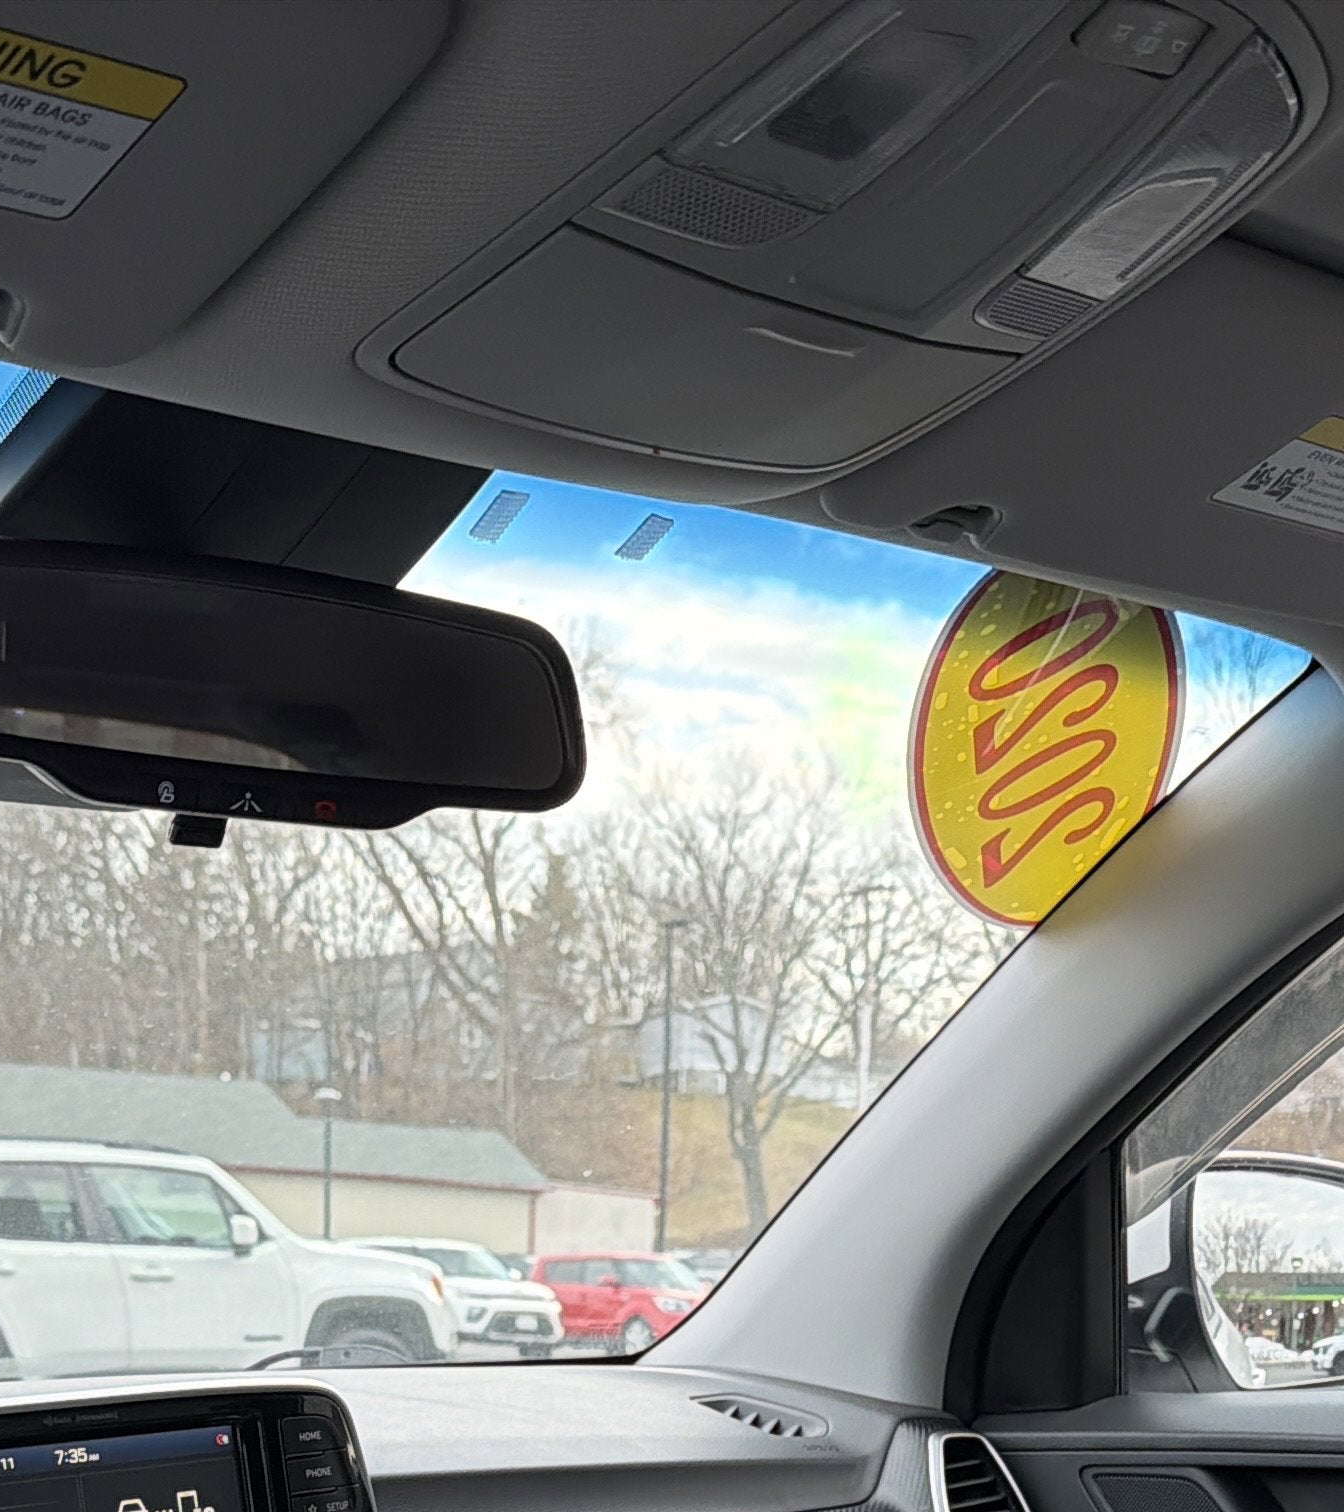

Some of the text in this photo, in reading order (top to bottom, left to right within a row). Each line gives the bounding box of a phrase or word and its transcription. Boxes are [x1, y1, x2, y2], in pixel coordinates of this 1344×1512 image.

[34, 99, 93, 128] BAGS
[1306, 450, 1332, 463] EVEN
[299, 1430, 322, 1441] HOME
[54, 1447, 88, 1465] 7:35
[0, 1457, 15, 1470] 11
[305, 1466, 332, 1478] PHONE
[326, 1499, 349, 1512] SETUP
